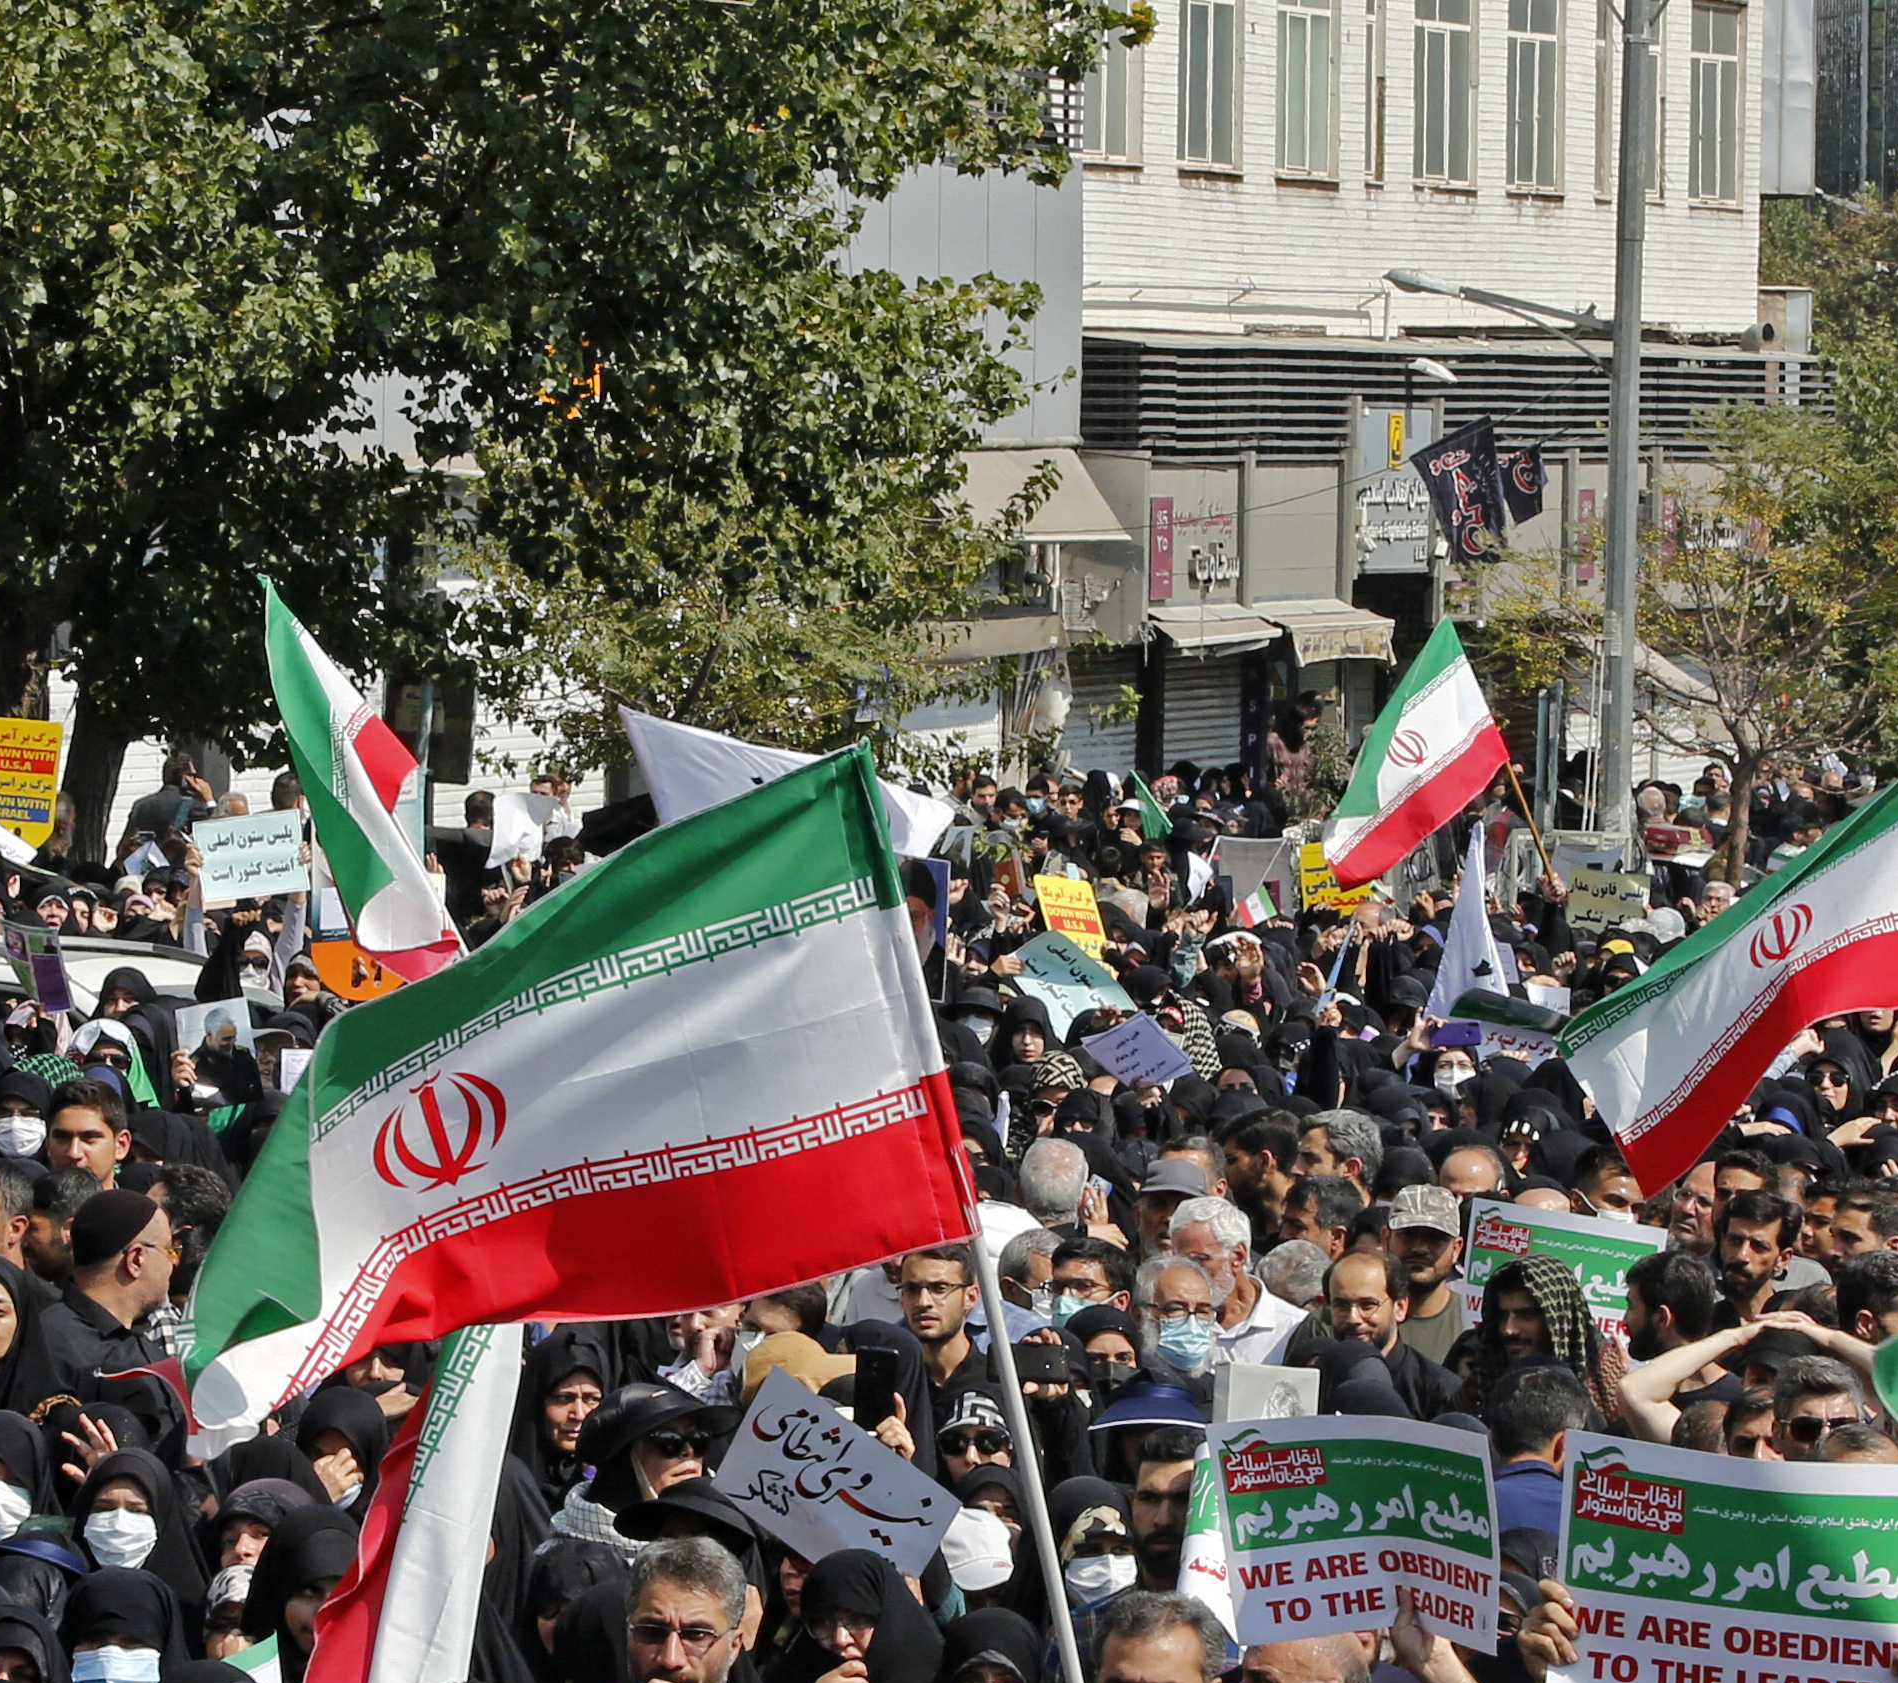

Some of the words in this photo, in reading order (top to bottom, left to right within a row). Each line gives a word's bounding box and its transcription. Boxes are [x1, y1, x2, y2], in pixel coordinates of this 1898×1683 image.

[33, 728, 59, 746] مرگ
[23, 748, 55, 762] WITH
[0, 760, 33, 772] U.S.A
[29, 778, 53, 791] مرگ
[17, 797, 50, 811] WITH
[208, 833, 234, 851] اصلی
[237, 831, 264, 849] ستون
[267, 825, 293, 845] پلیس
[211, 866, 233, 881] است
[237, 861, 263, 883] کشور
[265, 858, 295, 877] امنیت
[1569, 878, 1589, 893] مدار
[1593, 882, 1617, 898] قانون
[1620, 885, 1645, 901] پلیس
[1047, 905, 1071, 917] DOWN
[1071, 908, 1097, 921] WITH
[1062, 915, 1087, 931] U.S.A
[1226, 1453, 1272, 1473] اسلامی
[1271, 1448, 1321, 1466] انقلاب
[1229, 1467, 1275, 1491] استوار
[1579, 1470, 1629, 1500] اسلامی
[1632, 1480, 1682, 1510] انقلاب
[1369, 1483, 1416, 1530] امر
[1420, 1492, 1491, 1538] مطیع
[1577, 1497, 1629, 1521] استوار
[1692, 1504, 1719, 1516] هستند
[1720, 1508, 1749, 1521] رهبری
[1629, 1501, 1683, 1532] همچنان
[1760, 1512, 1788, 1525] اسلامی
[1789, 1514, 1818, 1529] انقلاب
[1844, 1517, 1870, 1530] عاشق
[1871, 1517, 1893, 1530] ایران
[1238, 1561, 1294, 1590] WE
[1305, 1552, 1369, 1582] ARE
[1378, 1550, 1493, 1597] OBEDIENT
[1721, 1544, 1792, 1601] امر
[1266, 1597, 1312, 1624] TO
[1321, 1587, 1386, 1617] THE
[1573, 1607, 1625, 1637] WE
[1637, 1614, 1711, 1650] ARE
[1587, 1650, 1639, 1683] TO
